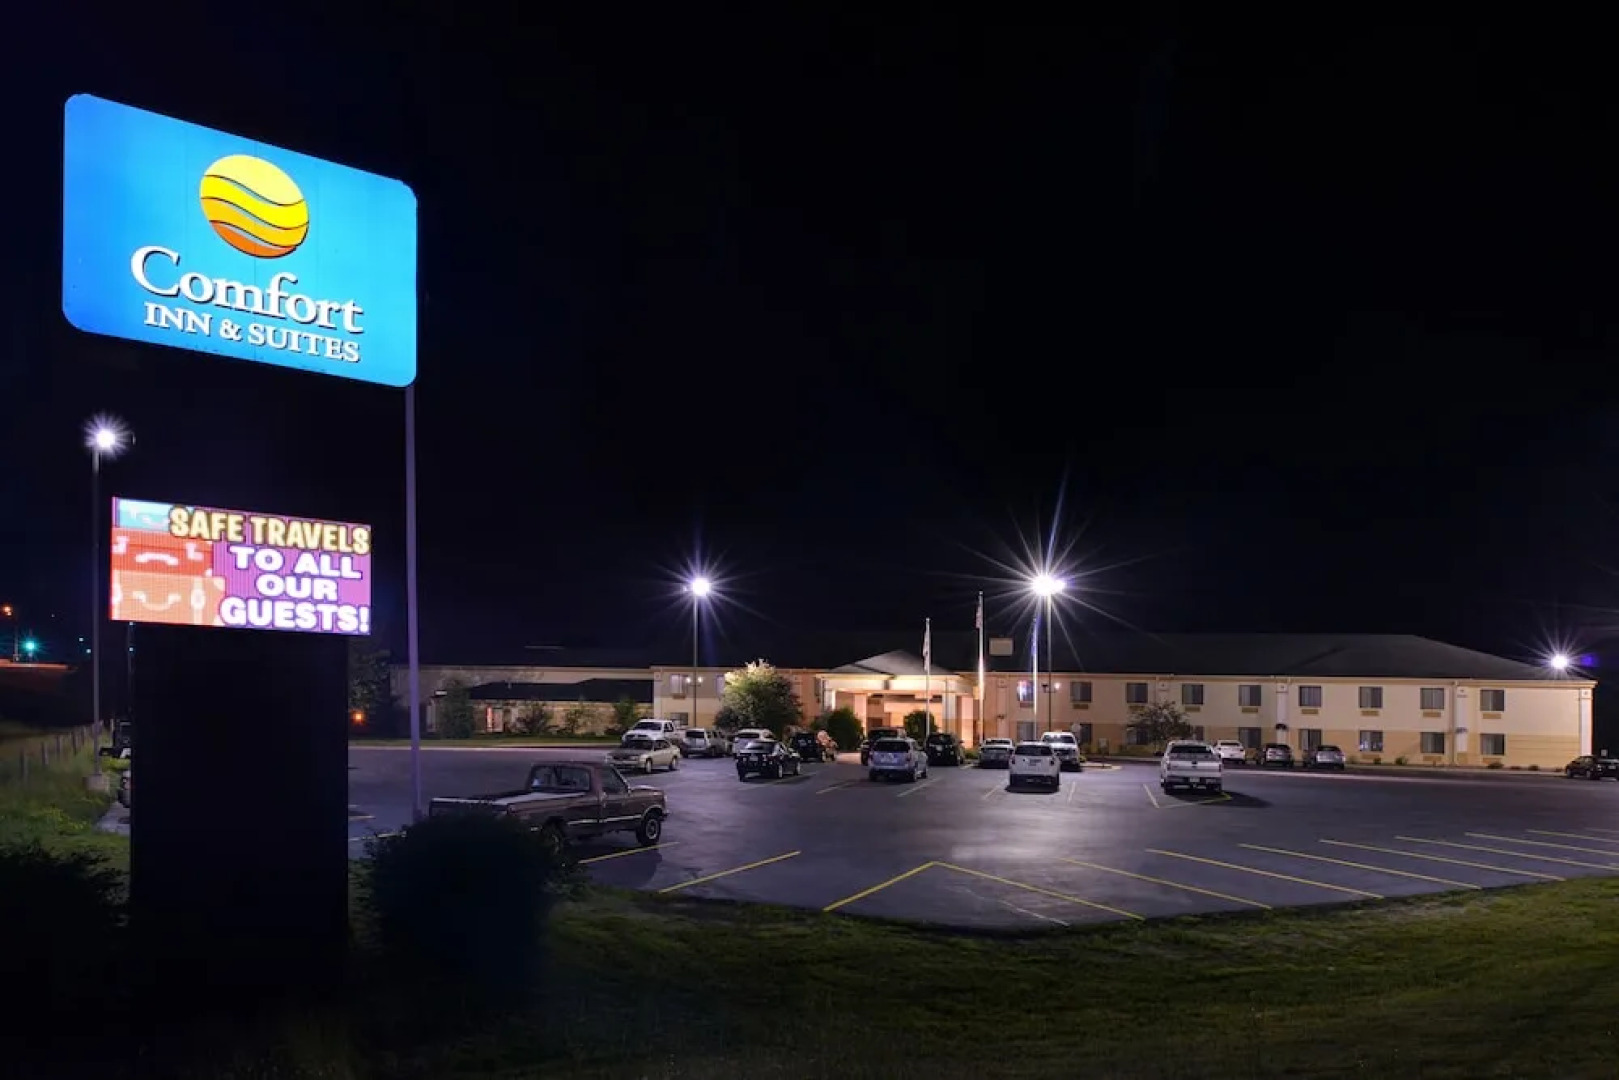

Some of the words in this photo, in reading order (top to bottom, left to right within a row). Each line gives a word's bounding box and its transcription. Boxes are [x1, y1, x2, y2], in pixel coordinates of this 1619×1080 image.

[131, 245, 364, 333] Comfort
[144, 302, 213, 336] INN
[219, 319, 243, 342] &
[248, 322, 361, 362] SUITES
[169, 505, 246, 541] SAFE
[250, 516, 370, 554] TRAVELS
[229, 546, 283, 571] TO
[294, 552, 362, 579] ALL
[256, 575, 338, 601] OUR
[220, 597, 370, 633] GUESTS!
